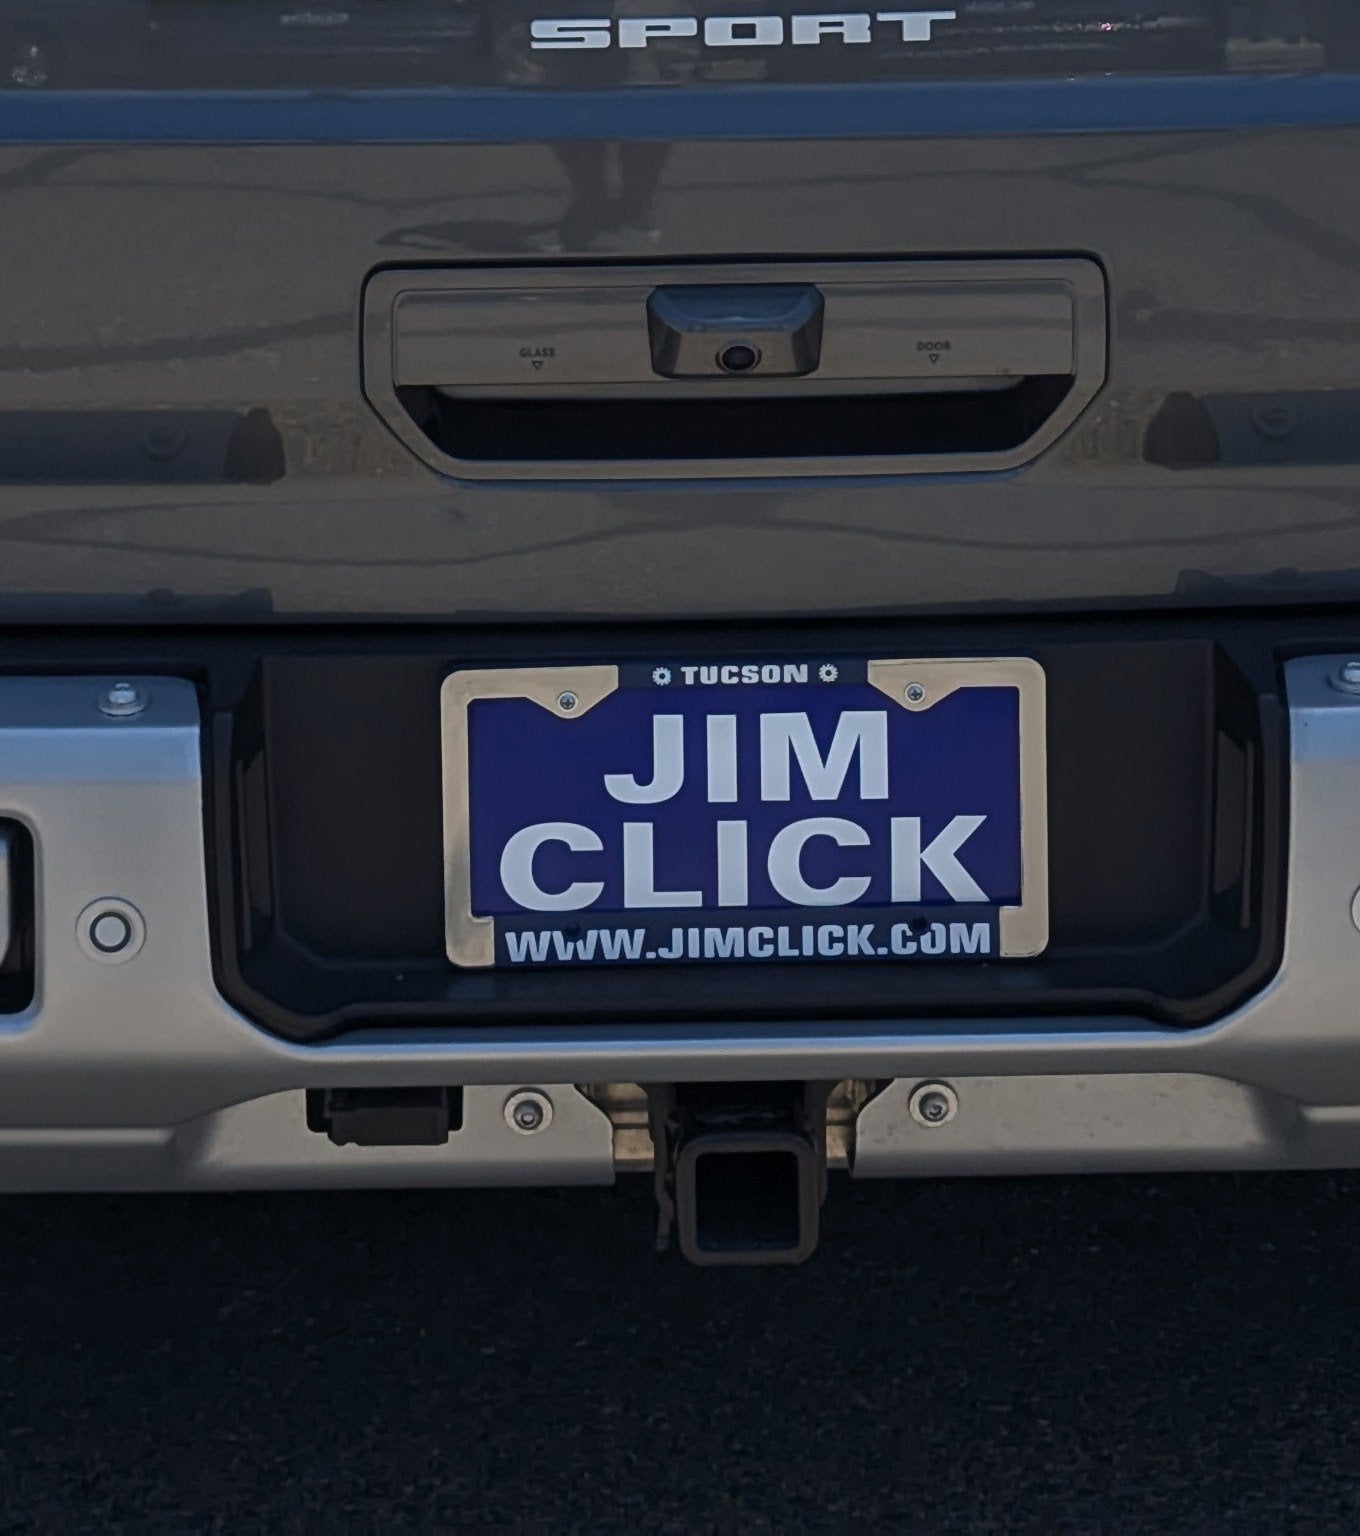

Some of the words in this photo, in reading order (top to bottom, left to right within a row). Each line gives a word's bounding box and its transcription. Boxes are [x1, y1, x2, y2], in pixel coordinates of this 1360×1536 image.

[529, 10, 957, 49] SPORT
[680, 663, 809, 686] TUCSON
[603, 710, 889, 804] JIM
[499, 814, 991, 912] CLICK
[504, 922, 991, 962] WWW.JIMCLICK.COM
